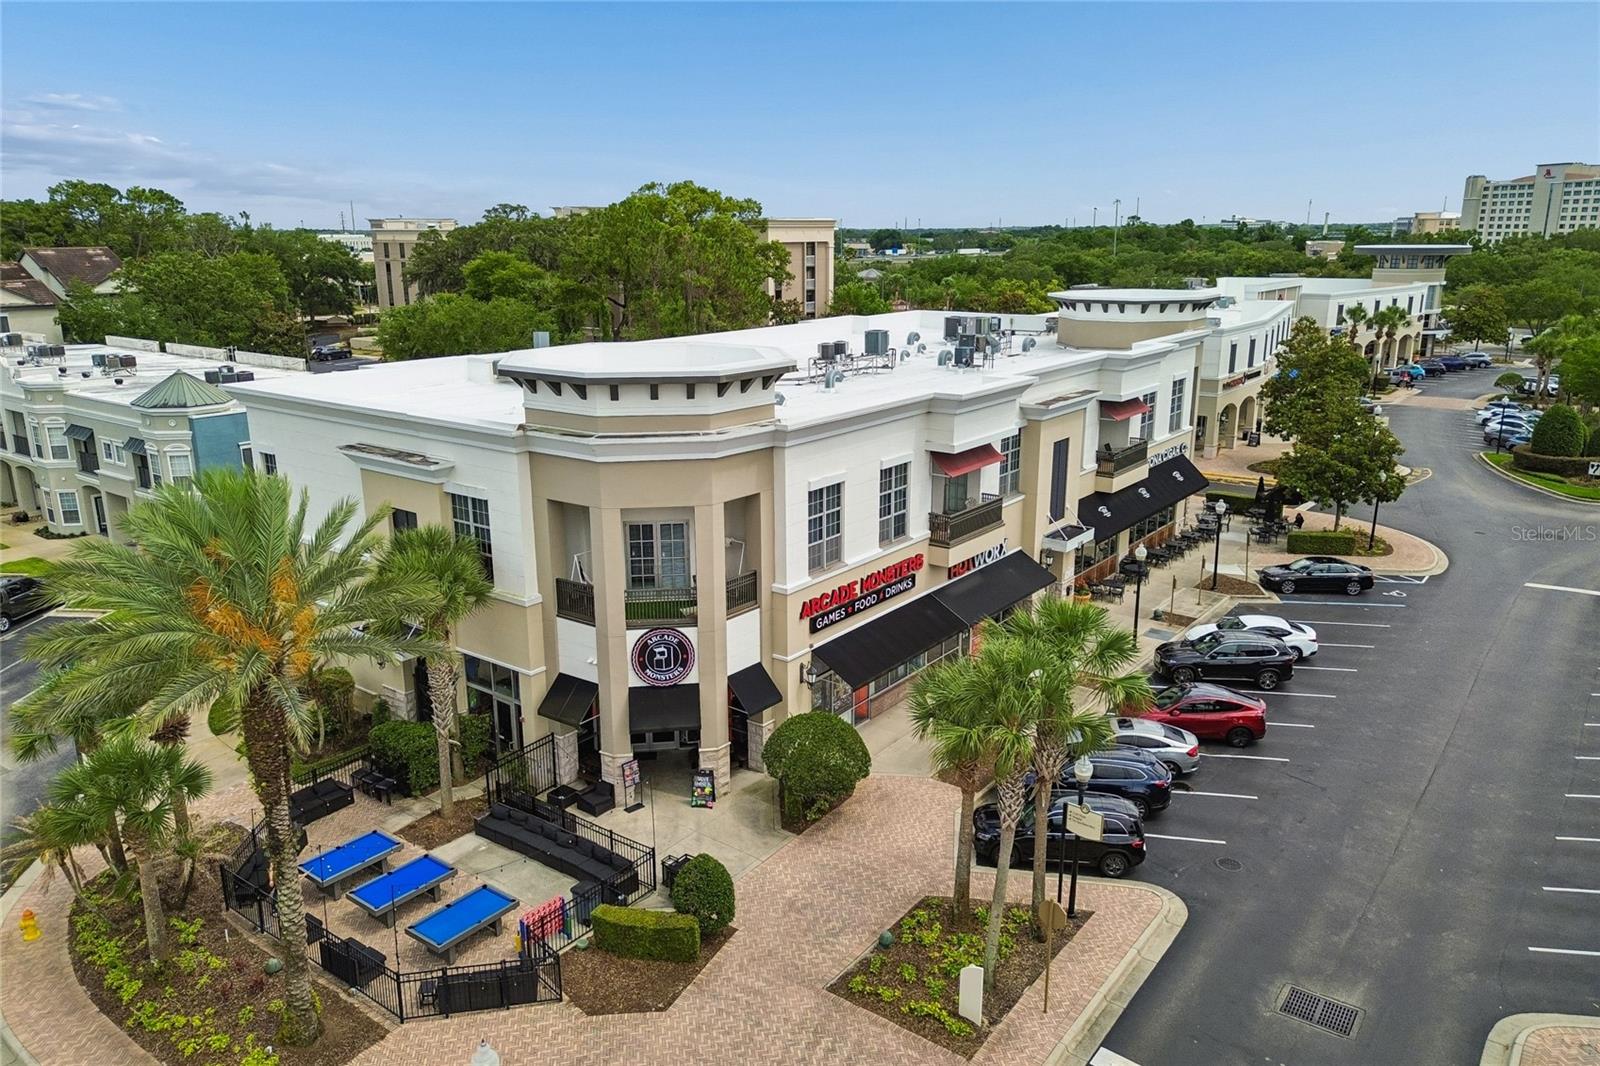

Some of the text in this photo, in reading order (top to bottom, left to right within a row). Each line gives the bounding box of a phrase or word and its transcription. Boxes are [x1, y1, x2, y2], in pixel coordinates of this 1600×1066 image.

[799, 553, 924, 620] ARCADE MONSTERS
[816, 577, 913, 629] GAMES FOOD DRINKS
[647, 634, 680, 646] ARCADE
[644, 666, 684, 681] MONSTERS
